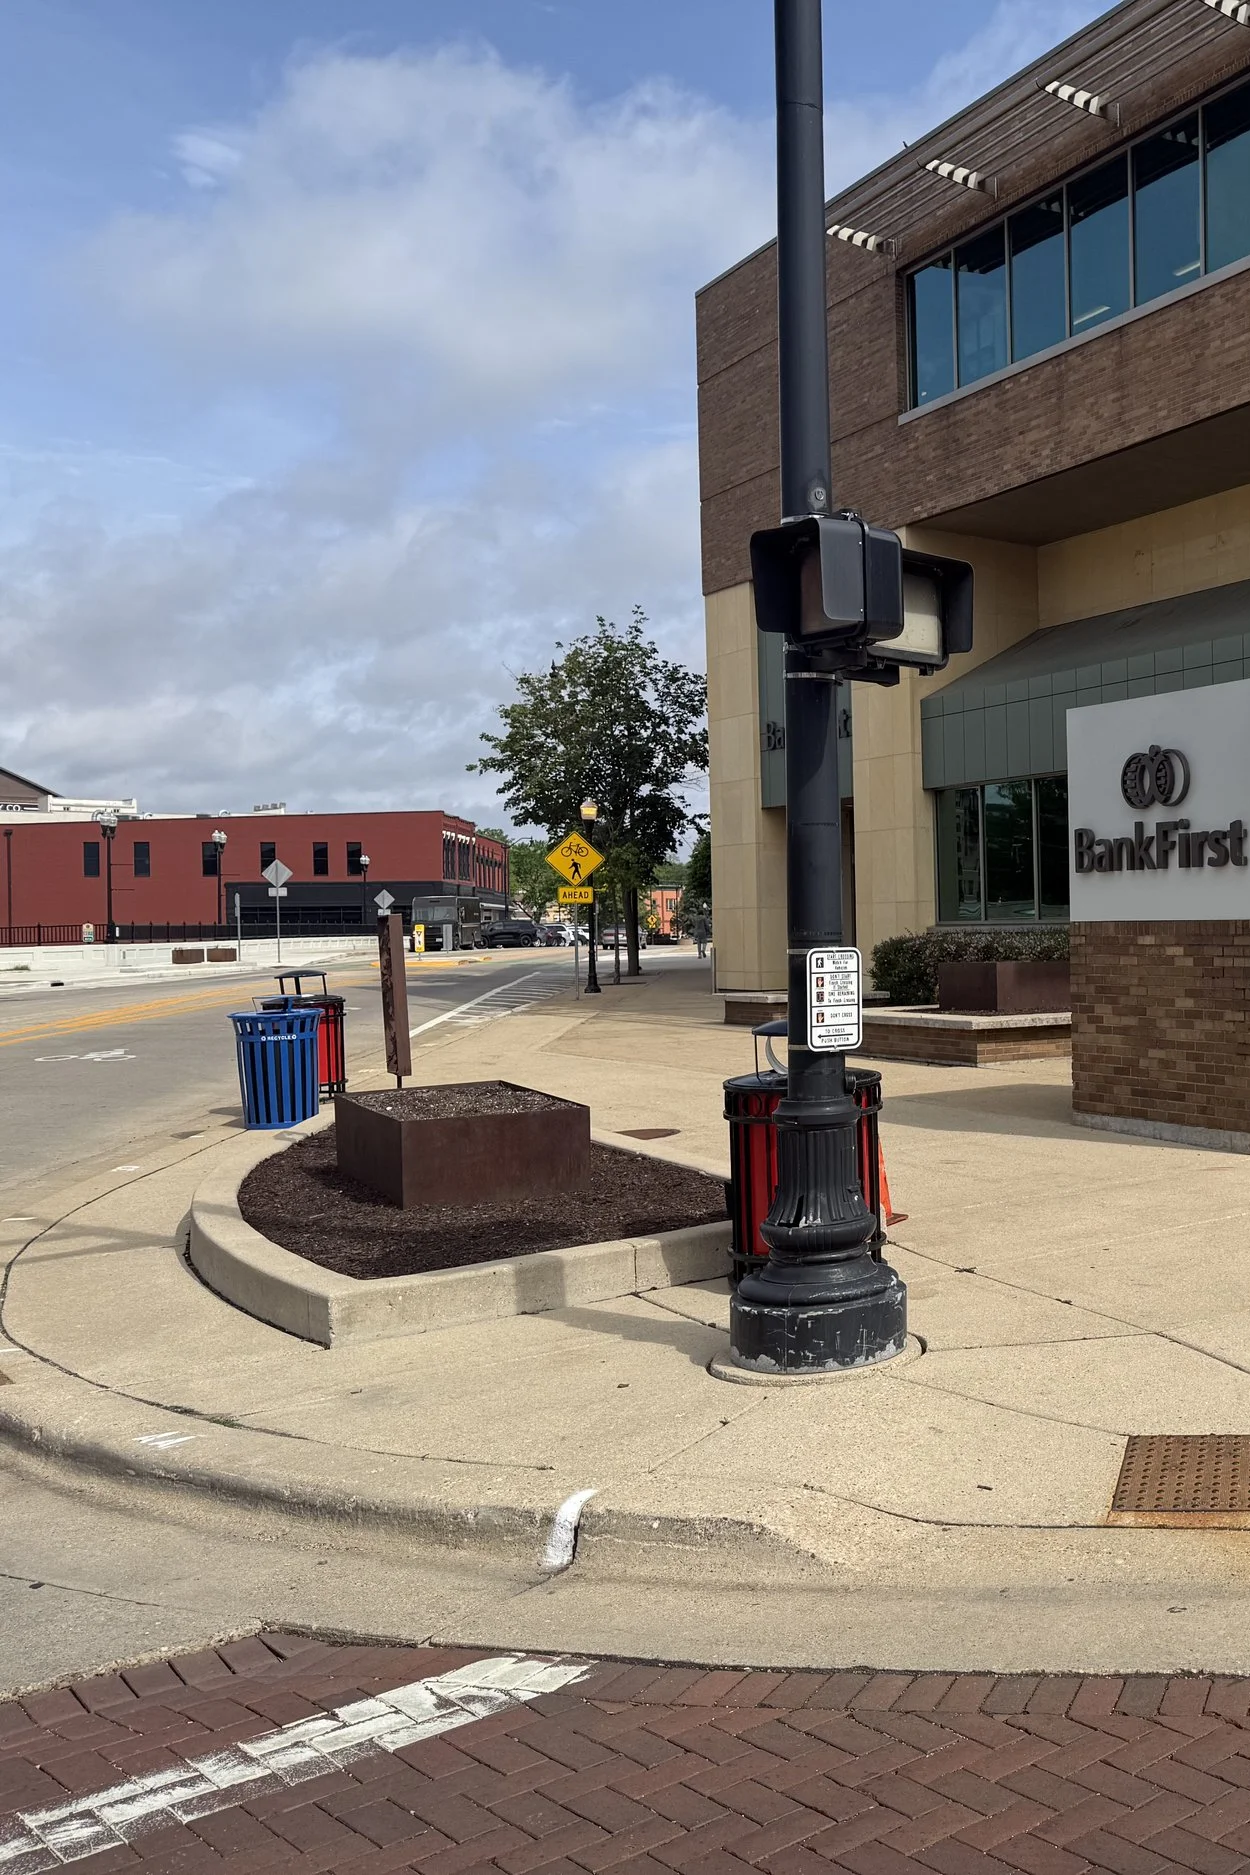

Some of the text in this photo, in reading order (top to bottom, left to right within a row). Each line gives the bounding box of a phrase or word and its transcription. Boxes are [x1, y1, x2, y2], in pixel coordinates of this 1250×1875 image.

[6, 804, 24, 812] CO.
[1074, 818, 1247, 873] BankFirst
[562, 891, 589, 899] AHEAD
